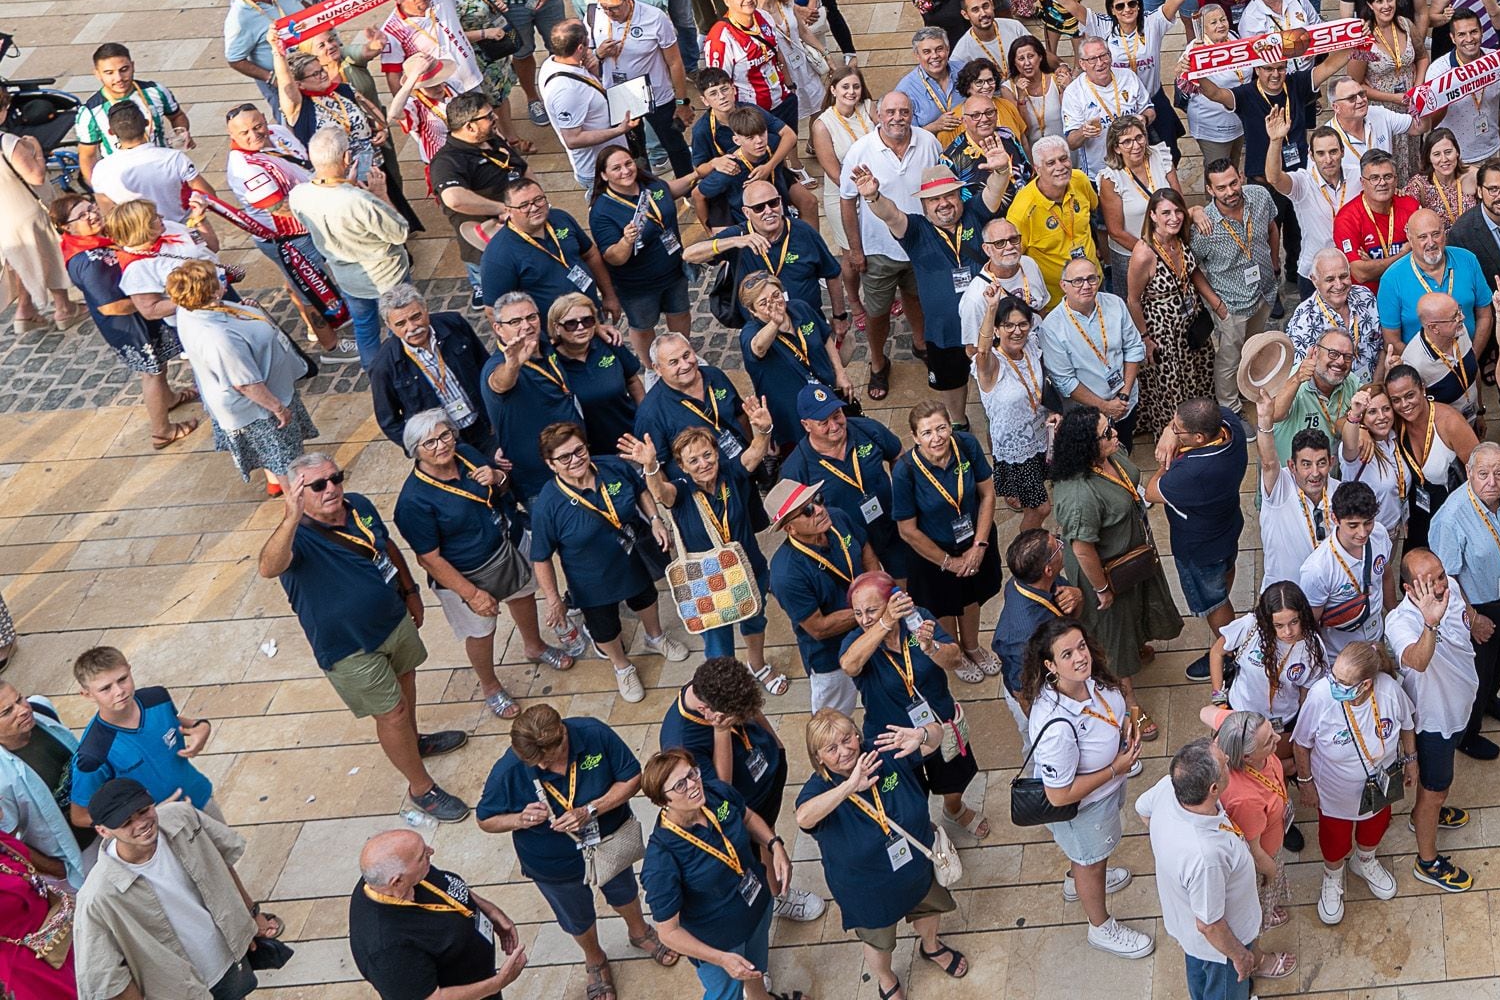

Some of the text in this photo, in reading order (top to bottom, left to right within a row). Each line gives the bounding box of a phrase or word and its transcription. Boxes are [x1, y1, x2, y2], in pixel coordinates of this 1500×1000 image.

[316, 2, 361, 23] NUNCA
[1195, 21, 1366, 70] FPS SFC
[1445, 91, 1460, 102] TUS
[1459, 72, 1496, 95] VICTORIAS
[1304, 415, 1319, 430] 78
